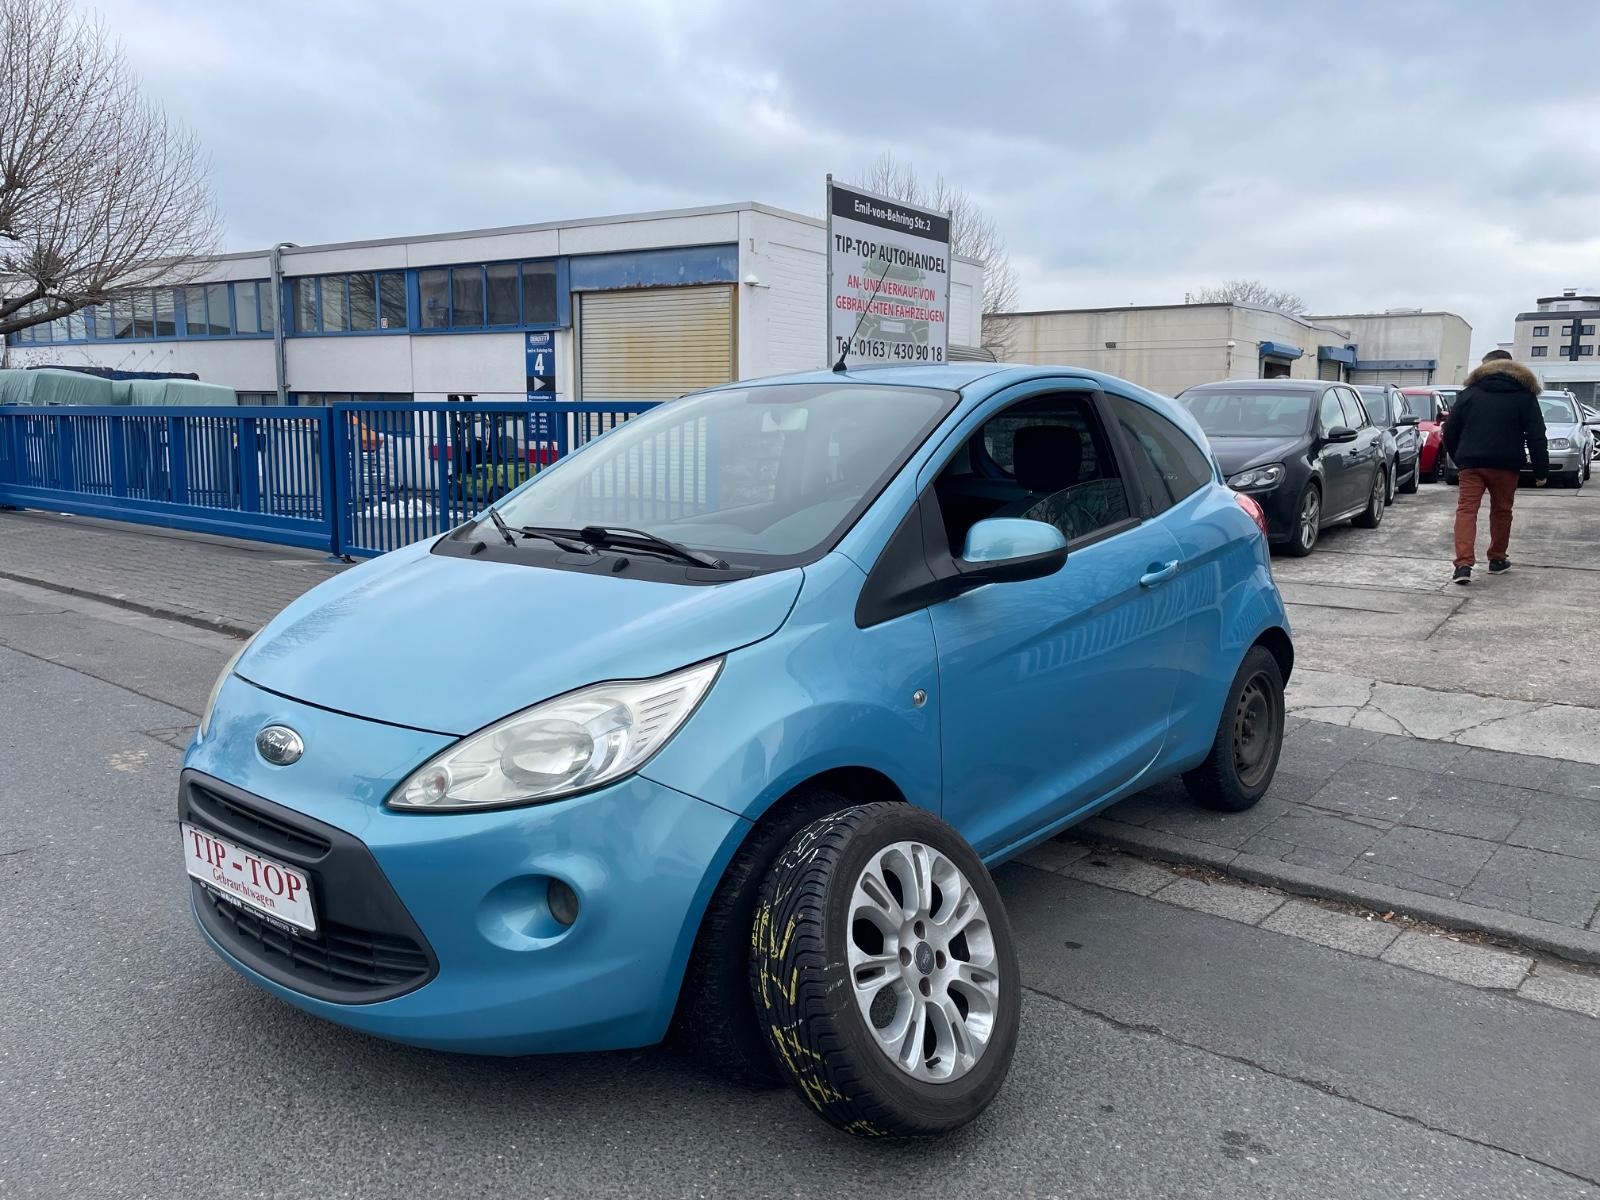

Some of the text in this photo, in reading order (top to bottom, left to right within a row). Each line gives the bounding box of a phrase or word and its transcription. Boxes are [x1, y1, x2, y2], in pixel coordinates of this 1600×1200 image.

[854, 200, 931, 231] Emil-von-Behring Str. 2
[835, 235, 946, 273] TIP-TOP AUTOHANDEL
[847, 275, 936, 301] AN- UND VERKAUF VON
[836, 295, 945, 323] GEBRAUCHTEN FAHRZEUGEN
[836, 336, 857, 356] Tel.:
[859, 339, 885, 359] 0163
[894, 344, 914, 360] 430
[916, 345, 928, 361] 90
[931, 346, 943, 362] 18
[534, 353, 545, 376] 4
[212, 868, 275, 908] Gebrauchtwagen
